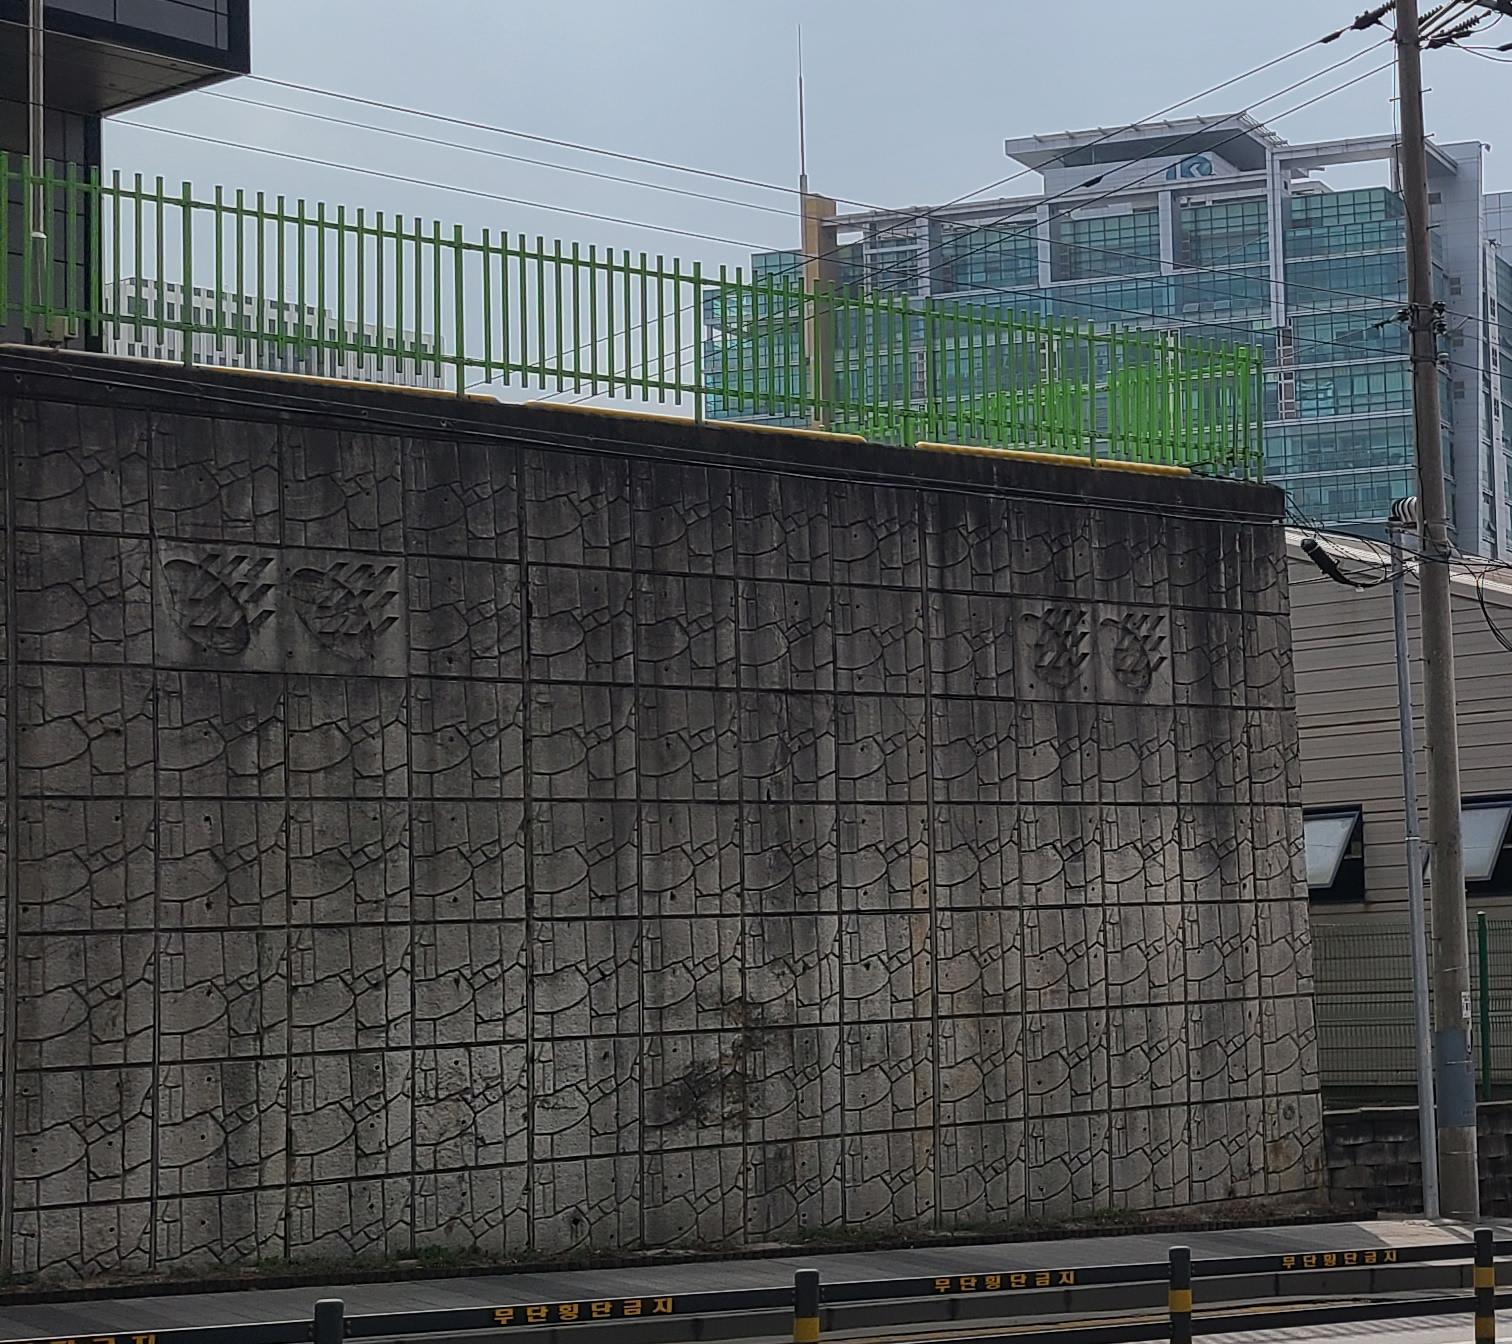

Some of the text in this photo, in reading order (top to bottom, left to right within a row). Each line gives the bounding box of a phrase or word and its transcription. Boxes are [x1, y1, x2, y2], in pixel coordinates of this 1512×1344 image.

[1282, 1250, 1397, 1269] 무단횡단금지
[934, 1271, 1076, 1293] 무단횡단금지
[493, 1296, 674, 1325] 무단횡단금지
